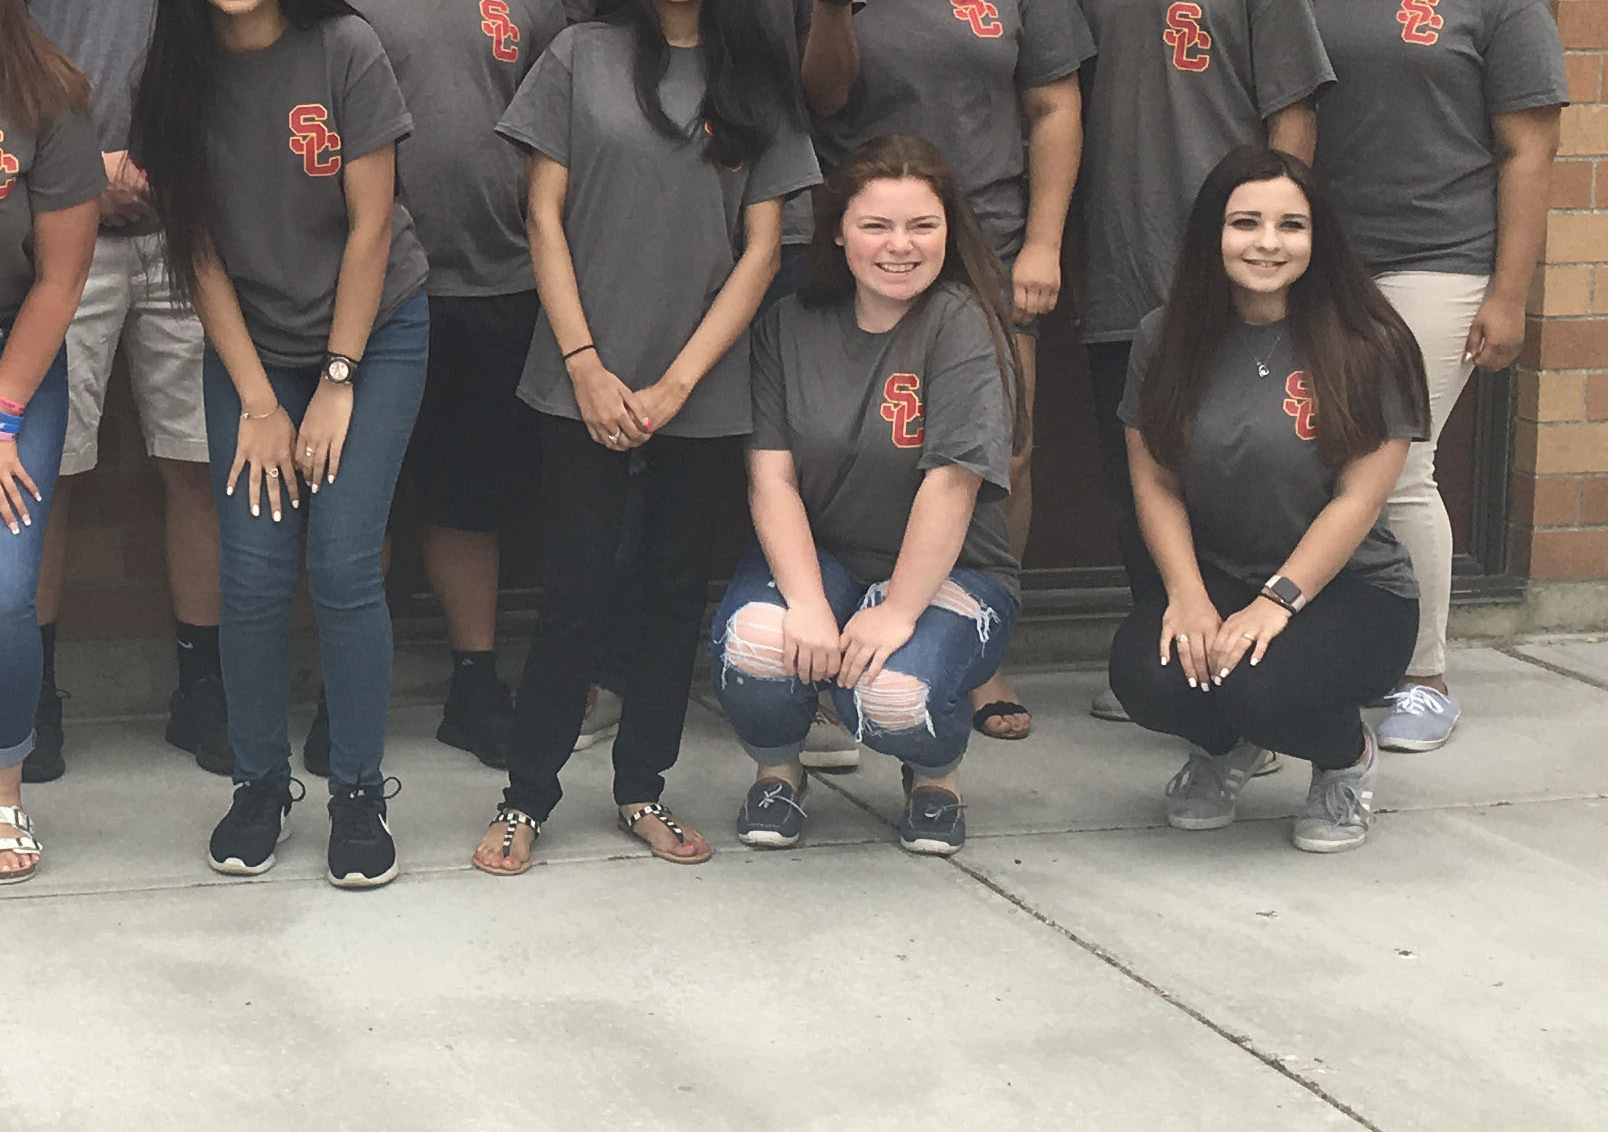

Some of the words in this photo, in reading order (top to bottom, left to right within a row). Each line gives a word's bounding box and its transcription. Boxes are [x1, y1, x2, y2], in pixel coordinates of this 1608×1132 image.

[1163, 1, 1212, 72] SC
[289, 103, 341, 177] SC
[880, 372, 924, 449] SC
